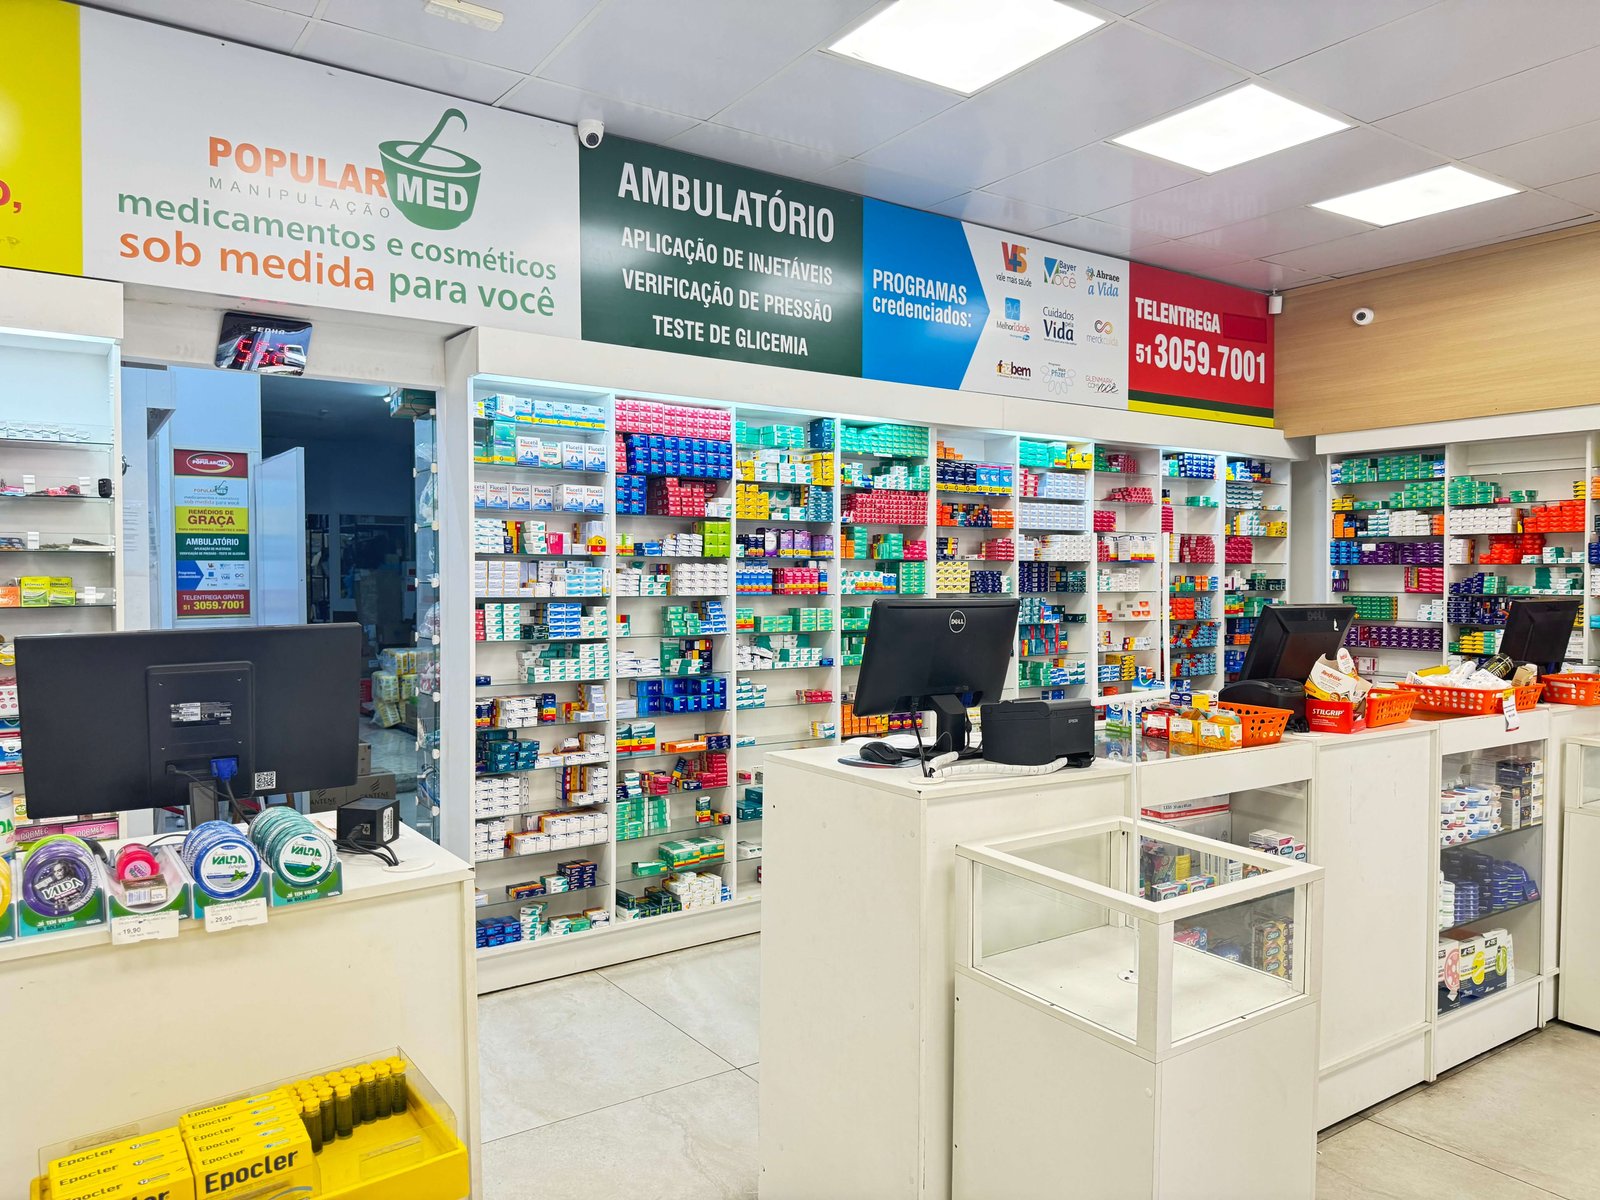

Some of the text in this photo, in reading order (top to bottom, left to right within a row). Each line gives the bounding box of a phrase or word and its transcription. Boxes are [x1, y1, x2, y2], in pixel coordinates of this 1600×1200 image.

[208, 136, 468, 212] POPULAR MED
[209, 176, 391, 219] MANIPULAÇÃO
[617, 161, 835, 243] AMBULATÓRIO
[117, 190, 558, 281] medicamentos e cosméticos
[621, 226, 833, 286] APLICAÇÃO DE INJETÁVEIS
[119, 230, 556, 317] sob medida para você
[1059, 260, 1077, 272] Bayer
[996, 272, 1033, 288] vale mais saúde
[1096, 269, 1120, 282] Abrace
[622, 267, 833, 323] VERIFICAÇÃO DE PRESSÃO
[872, 268, 968, 305] PROGRAMAS
[1087, 281, 1119, 297] a Vida
[872, 296, 973, 328] credenciados:
[1042, 306, 1075, 321] Cuidados
[1135, 296, 1221, 334] TELENTREGA
[652, 314, 809, 357] TESTE DE GLICEMIA
[1043, 318, 1074, 341] Vida
[1135, 333, 1266, 384] 51 3059.7001
[1051, 369, 1067, 378] Pfizer
[188, 508, 223, 516] REMÉDIOS
[187, 515, 236, 528] GRAÇA
[186, 536, 240, 546] AMBULATÓRIO
[193, 600, 245, 610] 3059.7001
[1311, 708, 1344, 717] STILGRIP
[311, 797, 337, 806] ANTENE
[291, 845, 323, 857] VALDA
[212, 854, 247, 866] VALDA
[42, 877, 84, 900] VALDA
[187, 1105, 229, 1119] Epocler
[191, 1115, 233, 1130] Epocler
[193, 1126, 236, 1142] Epocler
[198, 1136, 242, 1152] Epocler
[57, 1147, 116, 1168] Epocler
[201, 1149, 246, 1166] Epocler
[59, 1164, 119, 1187] Epocler
[205, 1150, 299, 1195] Epocler
[64, 1183, 124, 1200] pocler
